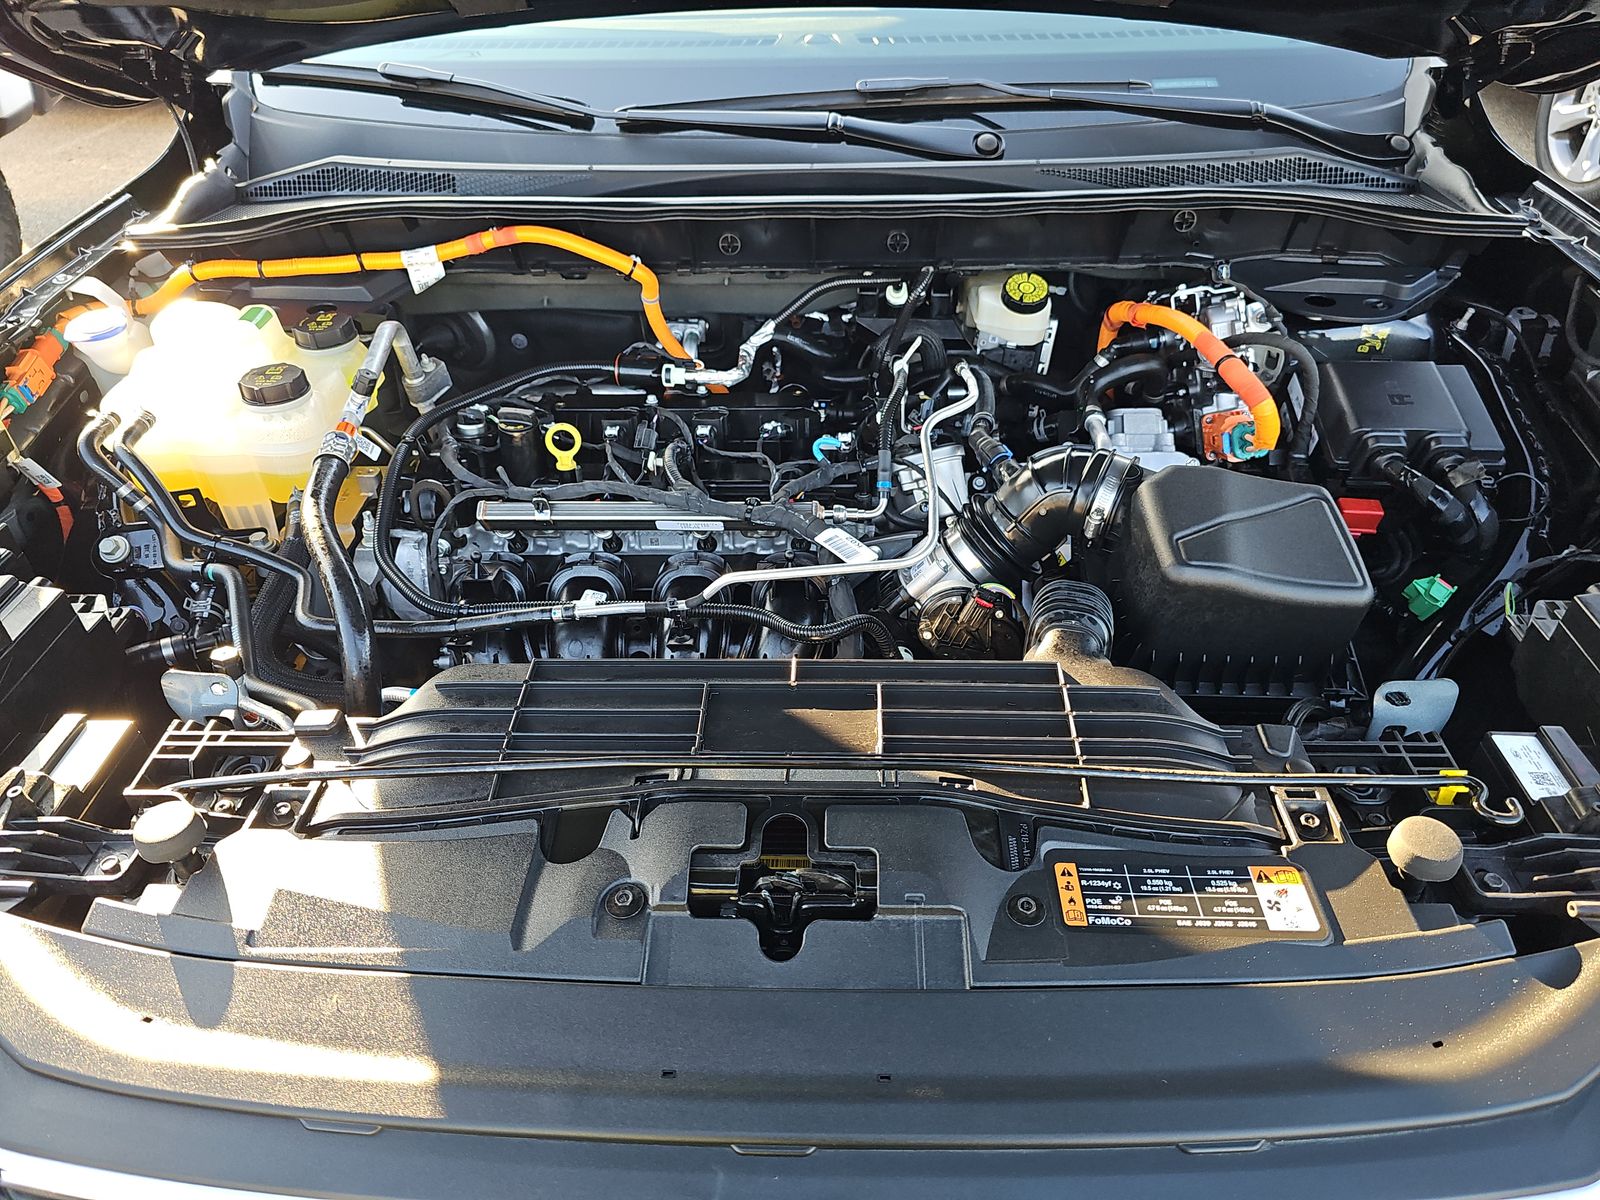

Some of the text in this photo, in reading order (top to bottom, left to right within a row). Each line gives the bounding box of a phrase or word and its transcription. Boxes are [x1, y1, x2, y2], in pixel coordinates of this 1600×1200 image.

[1081, 879, 1112, 888] R-1234yf
[1163, 879, 1173, 887] kg
[1088, 916, 1132, 926] FoMoCo
